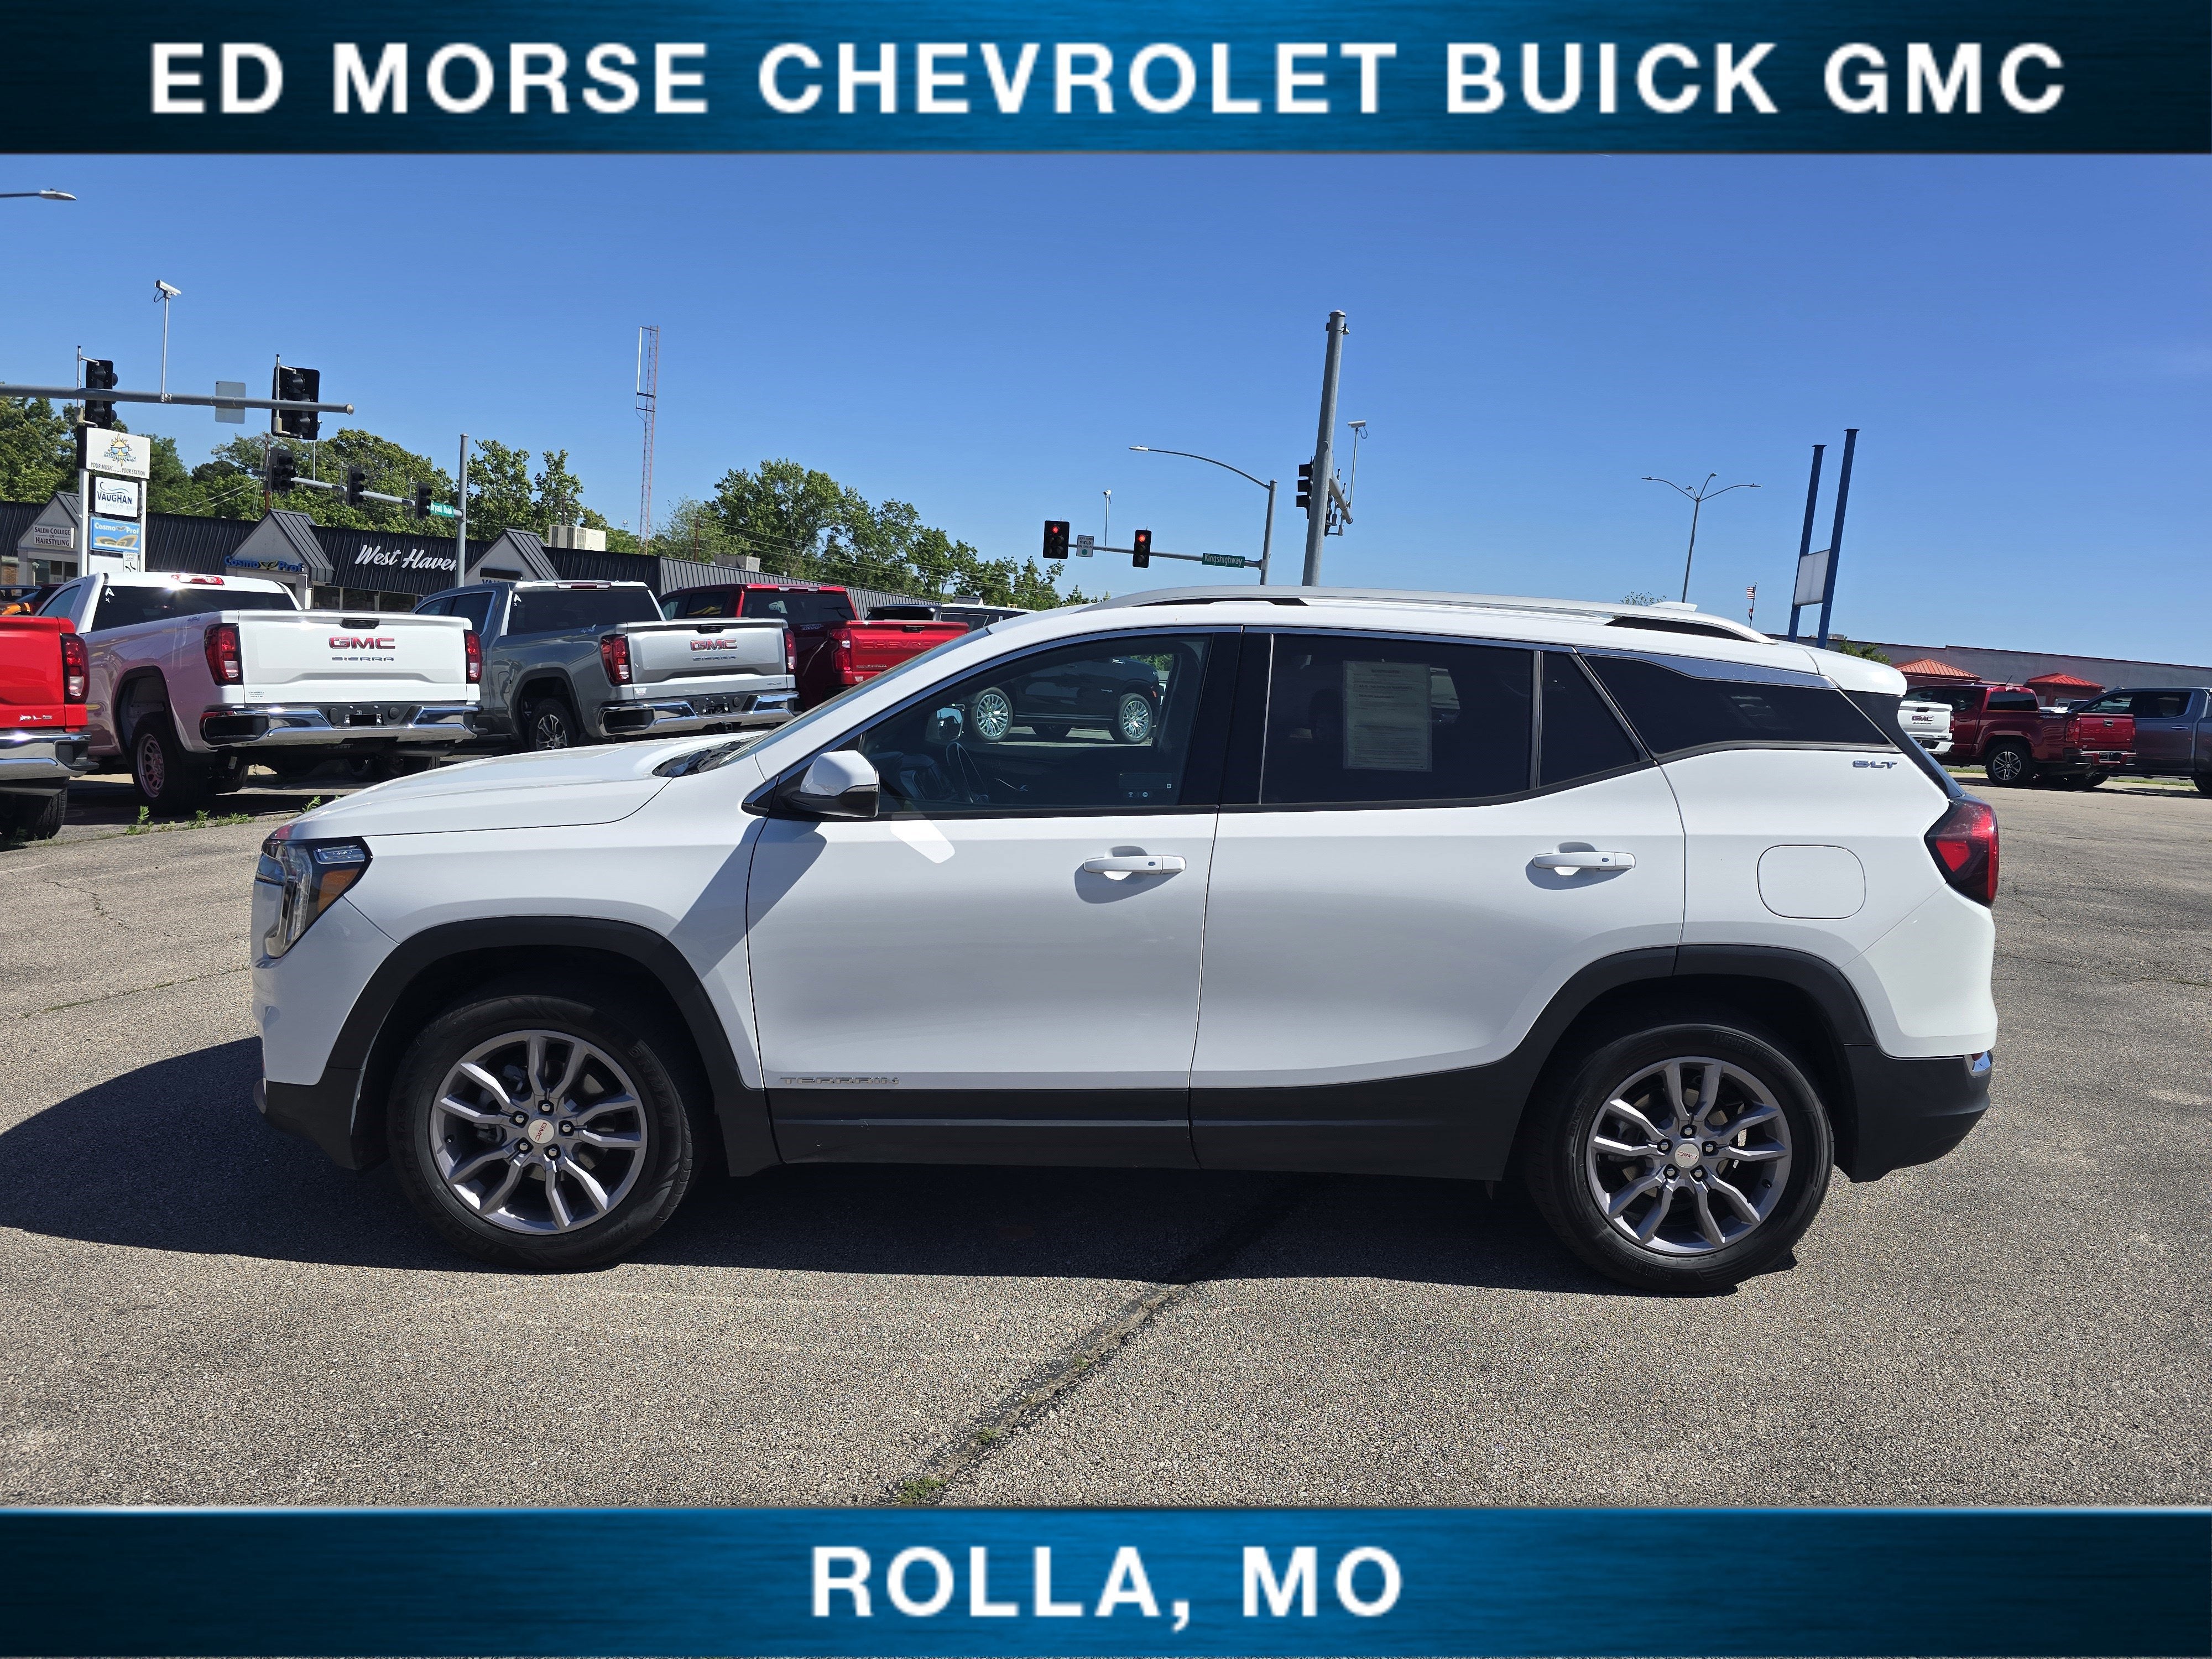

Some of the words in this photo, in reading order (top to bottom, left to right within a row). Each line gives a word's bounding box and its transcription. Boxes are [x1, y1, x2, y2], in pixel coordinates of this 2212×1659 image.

[97, 491, 132, 505] VAUGHAN
[95, 522, 116, 532] Cosmo
[126, 526, 139, 535] Prof
[35, 537, 70, 546] HAIRSTYLING
[354, 544, 401, 566] West
[1204, 554, 1243, 567] Kingshighway
[224, 555, 260, 568] Cosmo
[278, 561, 304, 572] Prof
[328, 636, 396, 650] GMC
[690, 638, 738, 651] GMC
[861, 640, 935, 649] CHEVRO
[1853, 760, 1898, 769] SLT
[535, 1122, 547, 1141] GMC
